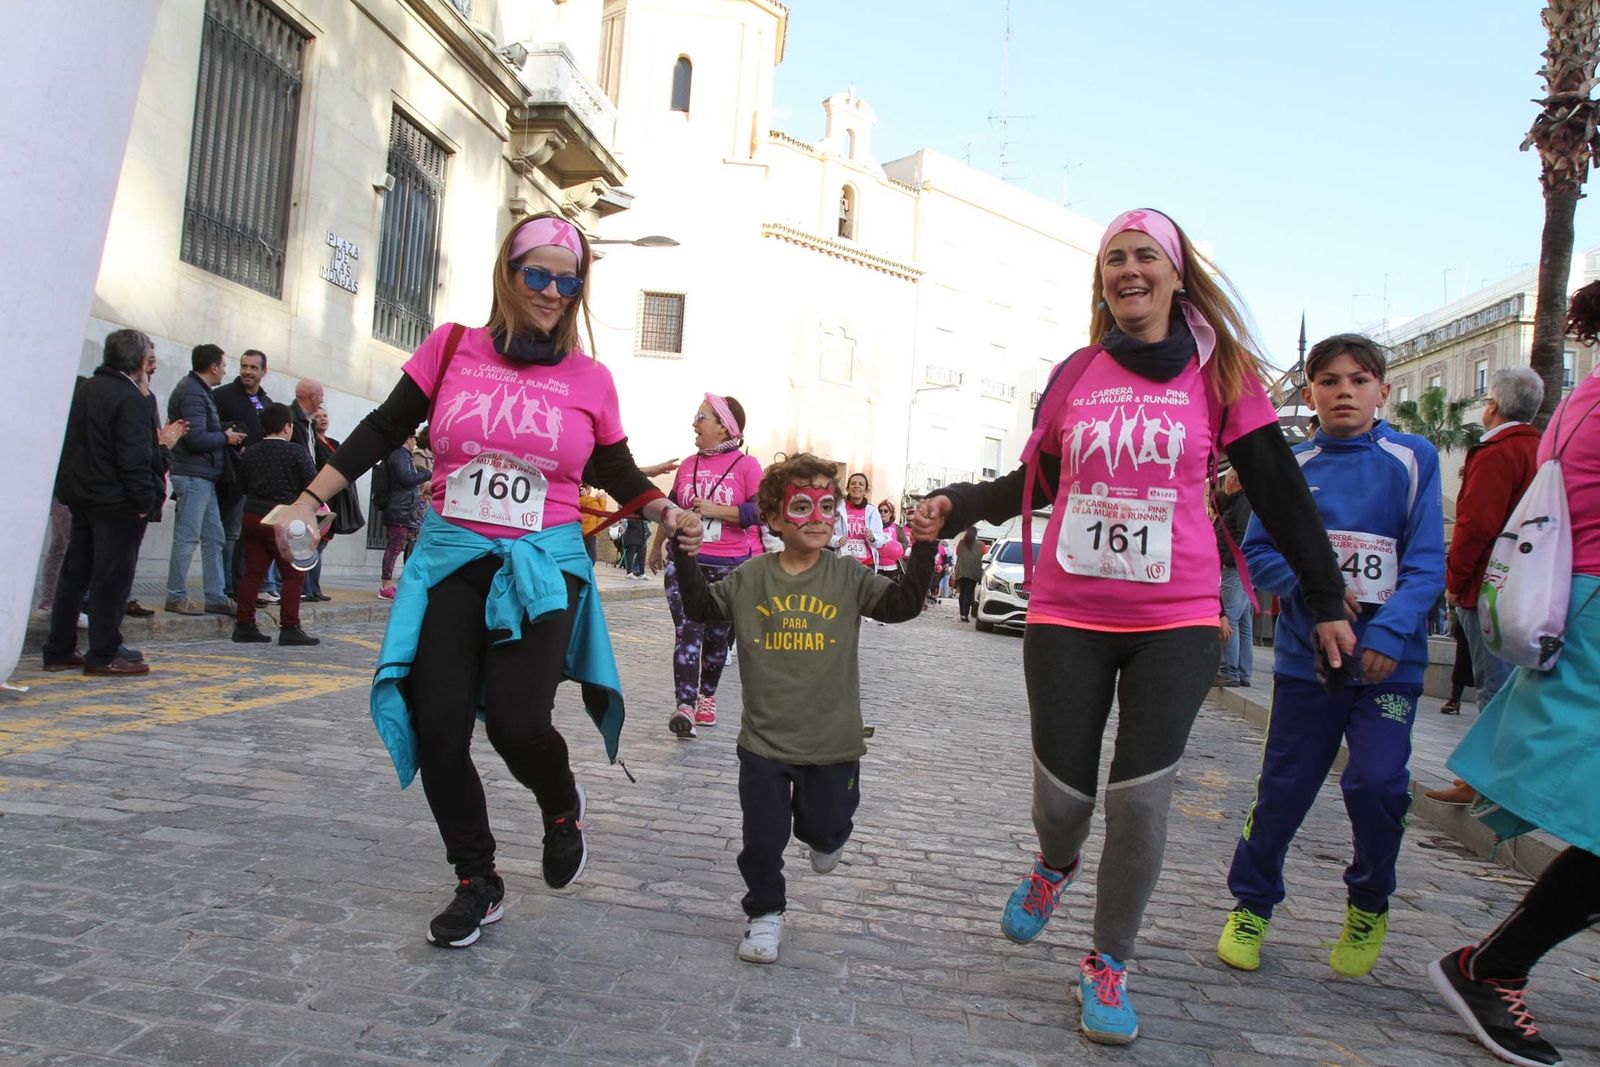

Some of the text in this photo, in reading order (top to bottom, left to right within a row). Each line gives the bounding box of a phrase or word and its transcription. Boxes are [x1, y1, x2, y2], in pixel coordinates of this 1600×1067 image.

[326, 230, 359, 260] PLAZA
[335, 249, 349, 265] DE
[331, 258, 351, 278] LAS
[319, 264, 359, 294] MONJAS
[460, 367, 472, 376] DE
[473, 369, 483, 378] LA
[485, 371, 517, 384] MUJER
[526, 379, 569, 397] RUNNING
[479, 363, 570, 390] CARRERA PINK
[1072, 398, 1085, 406] DE
[1085, 397, 1097, 406] LA
[1099, 394, 1133, 404] MUJER
[1143, 394, 1190, 406] RUNNING
[1090, 386, 1189, 400] CARRERA PINK
[469, 468, 531, 504] 160
[1082, 507, 1091, 515] LA
[1128, 511, 1168, 522] RUNNING
[1147, 505, 1168, 514] PINK
[1086, 520, 1148, 556] 161
[1331, 540, 1353, 549] UJER
[1360, 542, 1393, 554] RUNNING
[1334, 551, 1382, 580] 48
[755, 594, 837, 620] NACIDO
[782, 617, 808, 630] PARA
[765, 631, 825, 651] LUCHAR
[1388, 702, 1402, 716] 98
